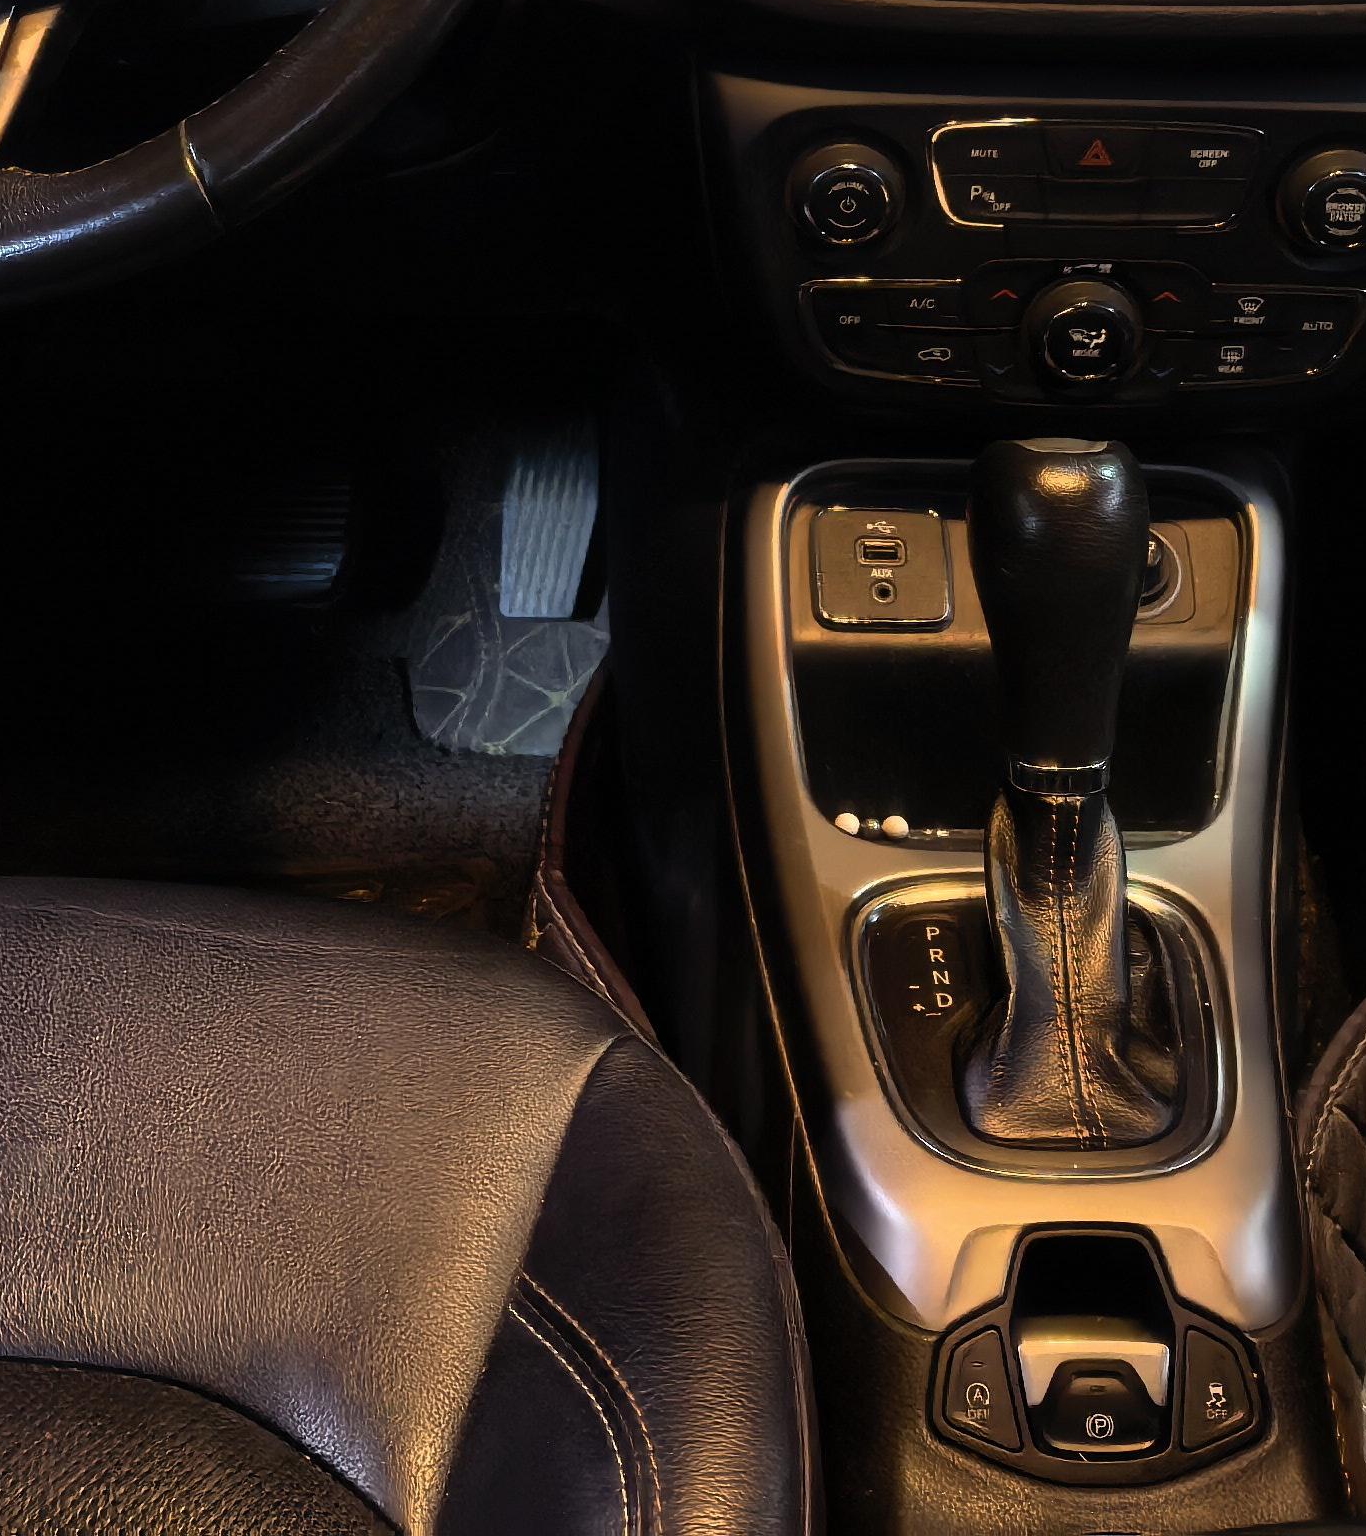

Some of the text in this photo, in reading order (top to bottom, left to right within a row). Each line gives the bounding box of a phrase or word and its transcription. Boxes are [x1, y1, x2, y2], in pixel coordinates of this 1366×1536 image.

[970, 148, 999, 159] MUTE
[909, 298, 937, 310] A/C
[839, 315, 861, 325] OFF
[1301, 321, 1334, 332] AUTO
[870, 567, 894, 579] AUX
[925, 926, 940, 941] P
[929, 948, 945, 963] R
[932, 970, 950, 985] N
[935, 992, 953, 1008] D
